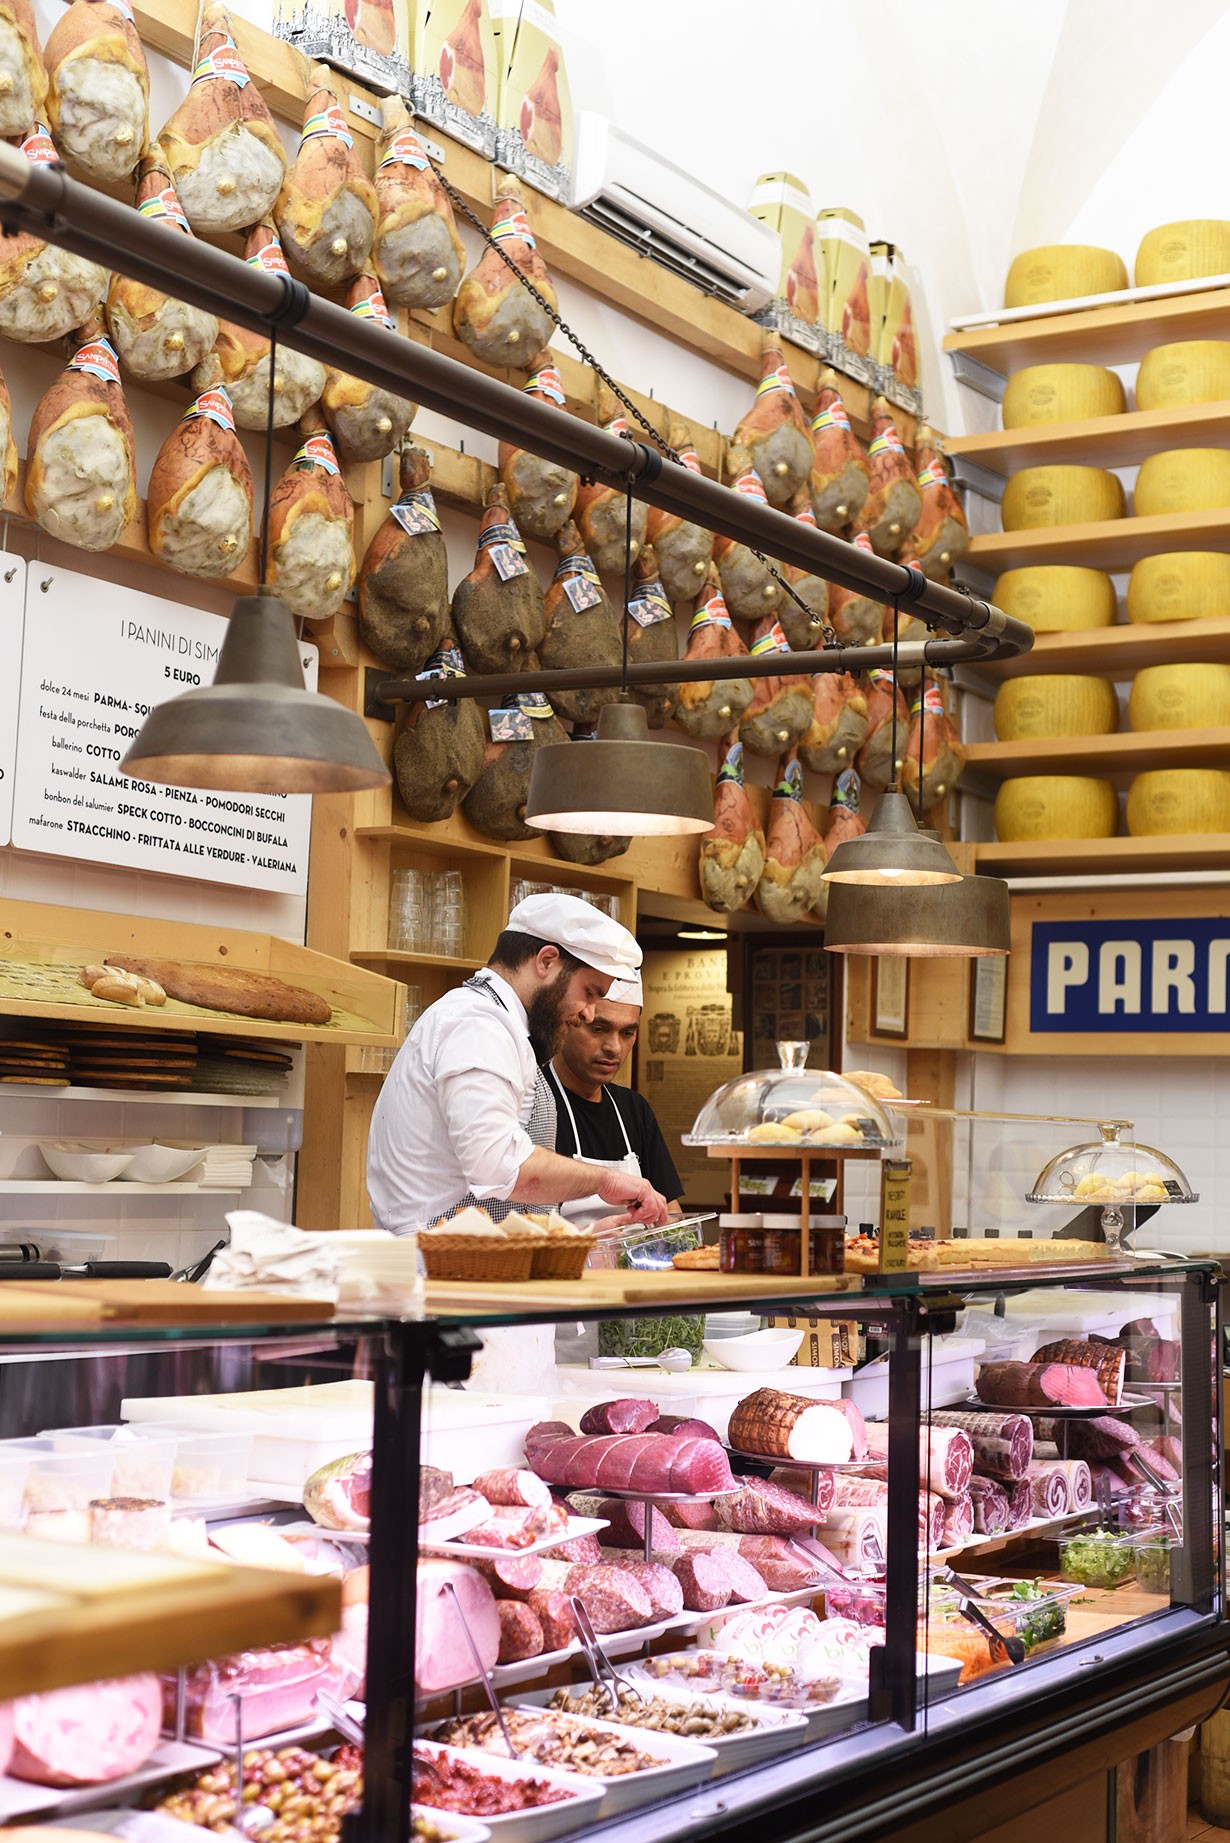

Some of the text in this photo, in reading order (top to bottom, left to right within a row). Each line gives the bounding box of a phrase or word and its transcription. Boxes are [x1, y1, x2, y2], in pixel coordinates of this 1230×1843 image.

[128, 622, 175, 651] PANINI
[178, 636, 192, 656] DI
[40, 679, 60, 694] dolce
[62, 687, 72, 697] 24
[73, 692, 90, 701] mesi
[164, 666, 201, 685] 5 EURO
[39, 705, 58, 721] festa
[59, 711, 76, 725] della
[77, 718, 111, 733] porchetta
[51, 736, 121, 761] ballerino COTTO
[51, 762, 87, 780] kaswalder
[90, 771, 129, 789] SALAME
[131, 780, 157, 796] ROSA
[165, 787, 198, 804] PIENZA
[206, 796, 254, 816] POMODORI
[255, 807, 285, 823] SECCHI
[44, 788, 71, 804] bonbon
[73, 794, 84, 807] del
[85, 798, 114, 813] salumier
[117, 803, 148, 820] SPECK
[150, 810, 182, 826] COTTO
[188, 818, 245, 839] BOCCONCINI
[246, 829, 255, 841] DI
[256, 831, 288, 847] BUFALA
[29, 814, 64, 830] mafarone
[67, 820, 131, 842] STRACCHINO
[138, 833, 181, 852] FRITTATA
[183, 843, 205, 856] ALLE
[206, 846, 246, 864] VERDURE
[251, 855, 297, 874] VALERIANA
